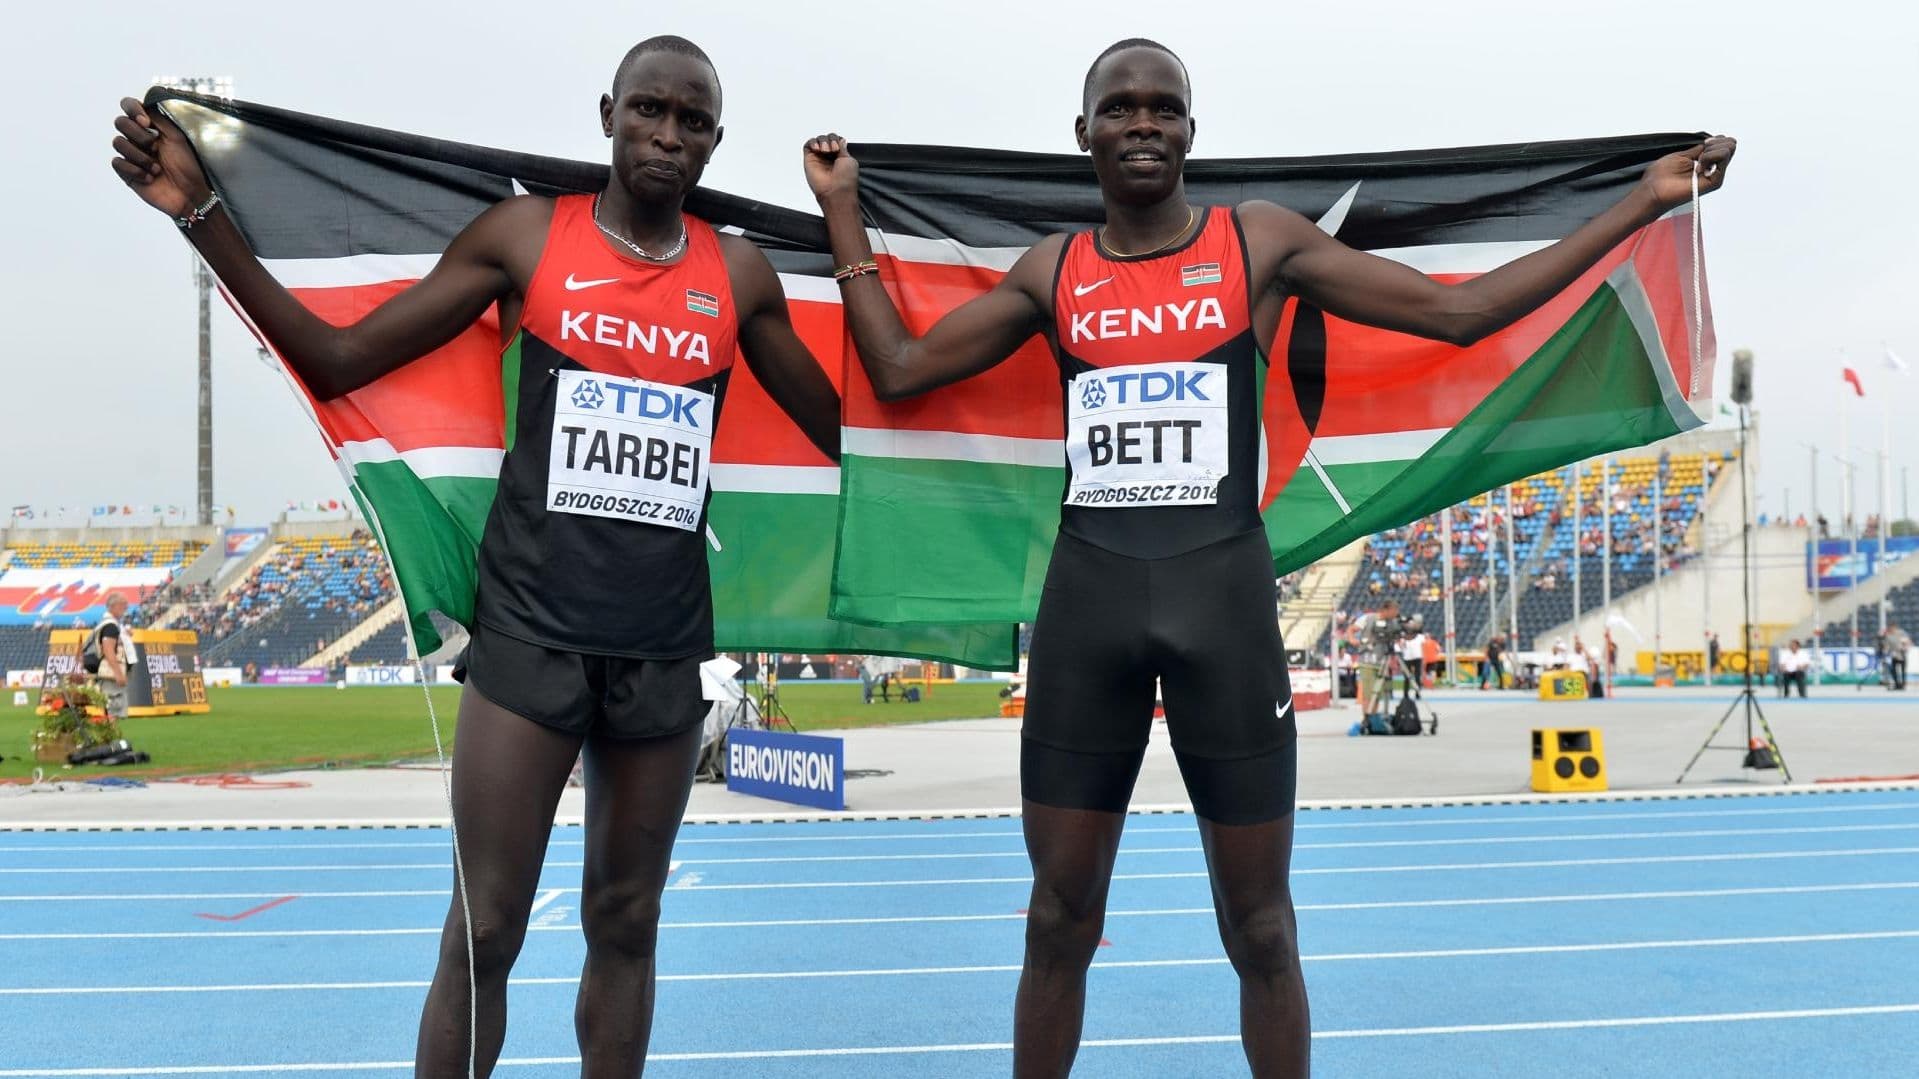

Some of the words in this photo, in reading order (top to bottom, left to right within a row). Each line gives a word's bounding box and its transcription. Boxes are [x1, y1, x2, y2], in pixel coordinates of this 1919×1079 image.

[561, 310, 710, 365] KENYA
[1071, 297, 1227, 343] KENYA
[605, 382, 702, 428] TDK
[1106, 370, 1211, 404] TDK
[561, 425, 700, 488] TARBEI
[1087, 420, 1201, 467] BETT
[553, 490, 663, 519] BYDGOSZCZ
[663, 505, 697, 525] 2016
[1074, 485, 1176, 503] BYDGOSZCZ
[1178, 485, 1218, 500] 2016
[370, 668, 401, 682] TDK
